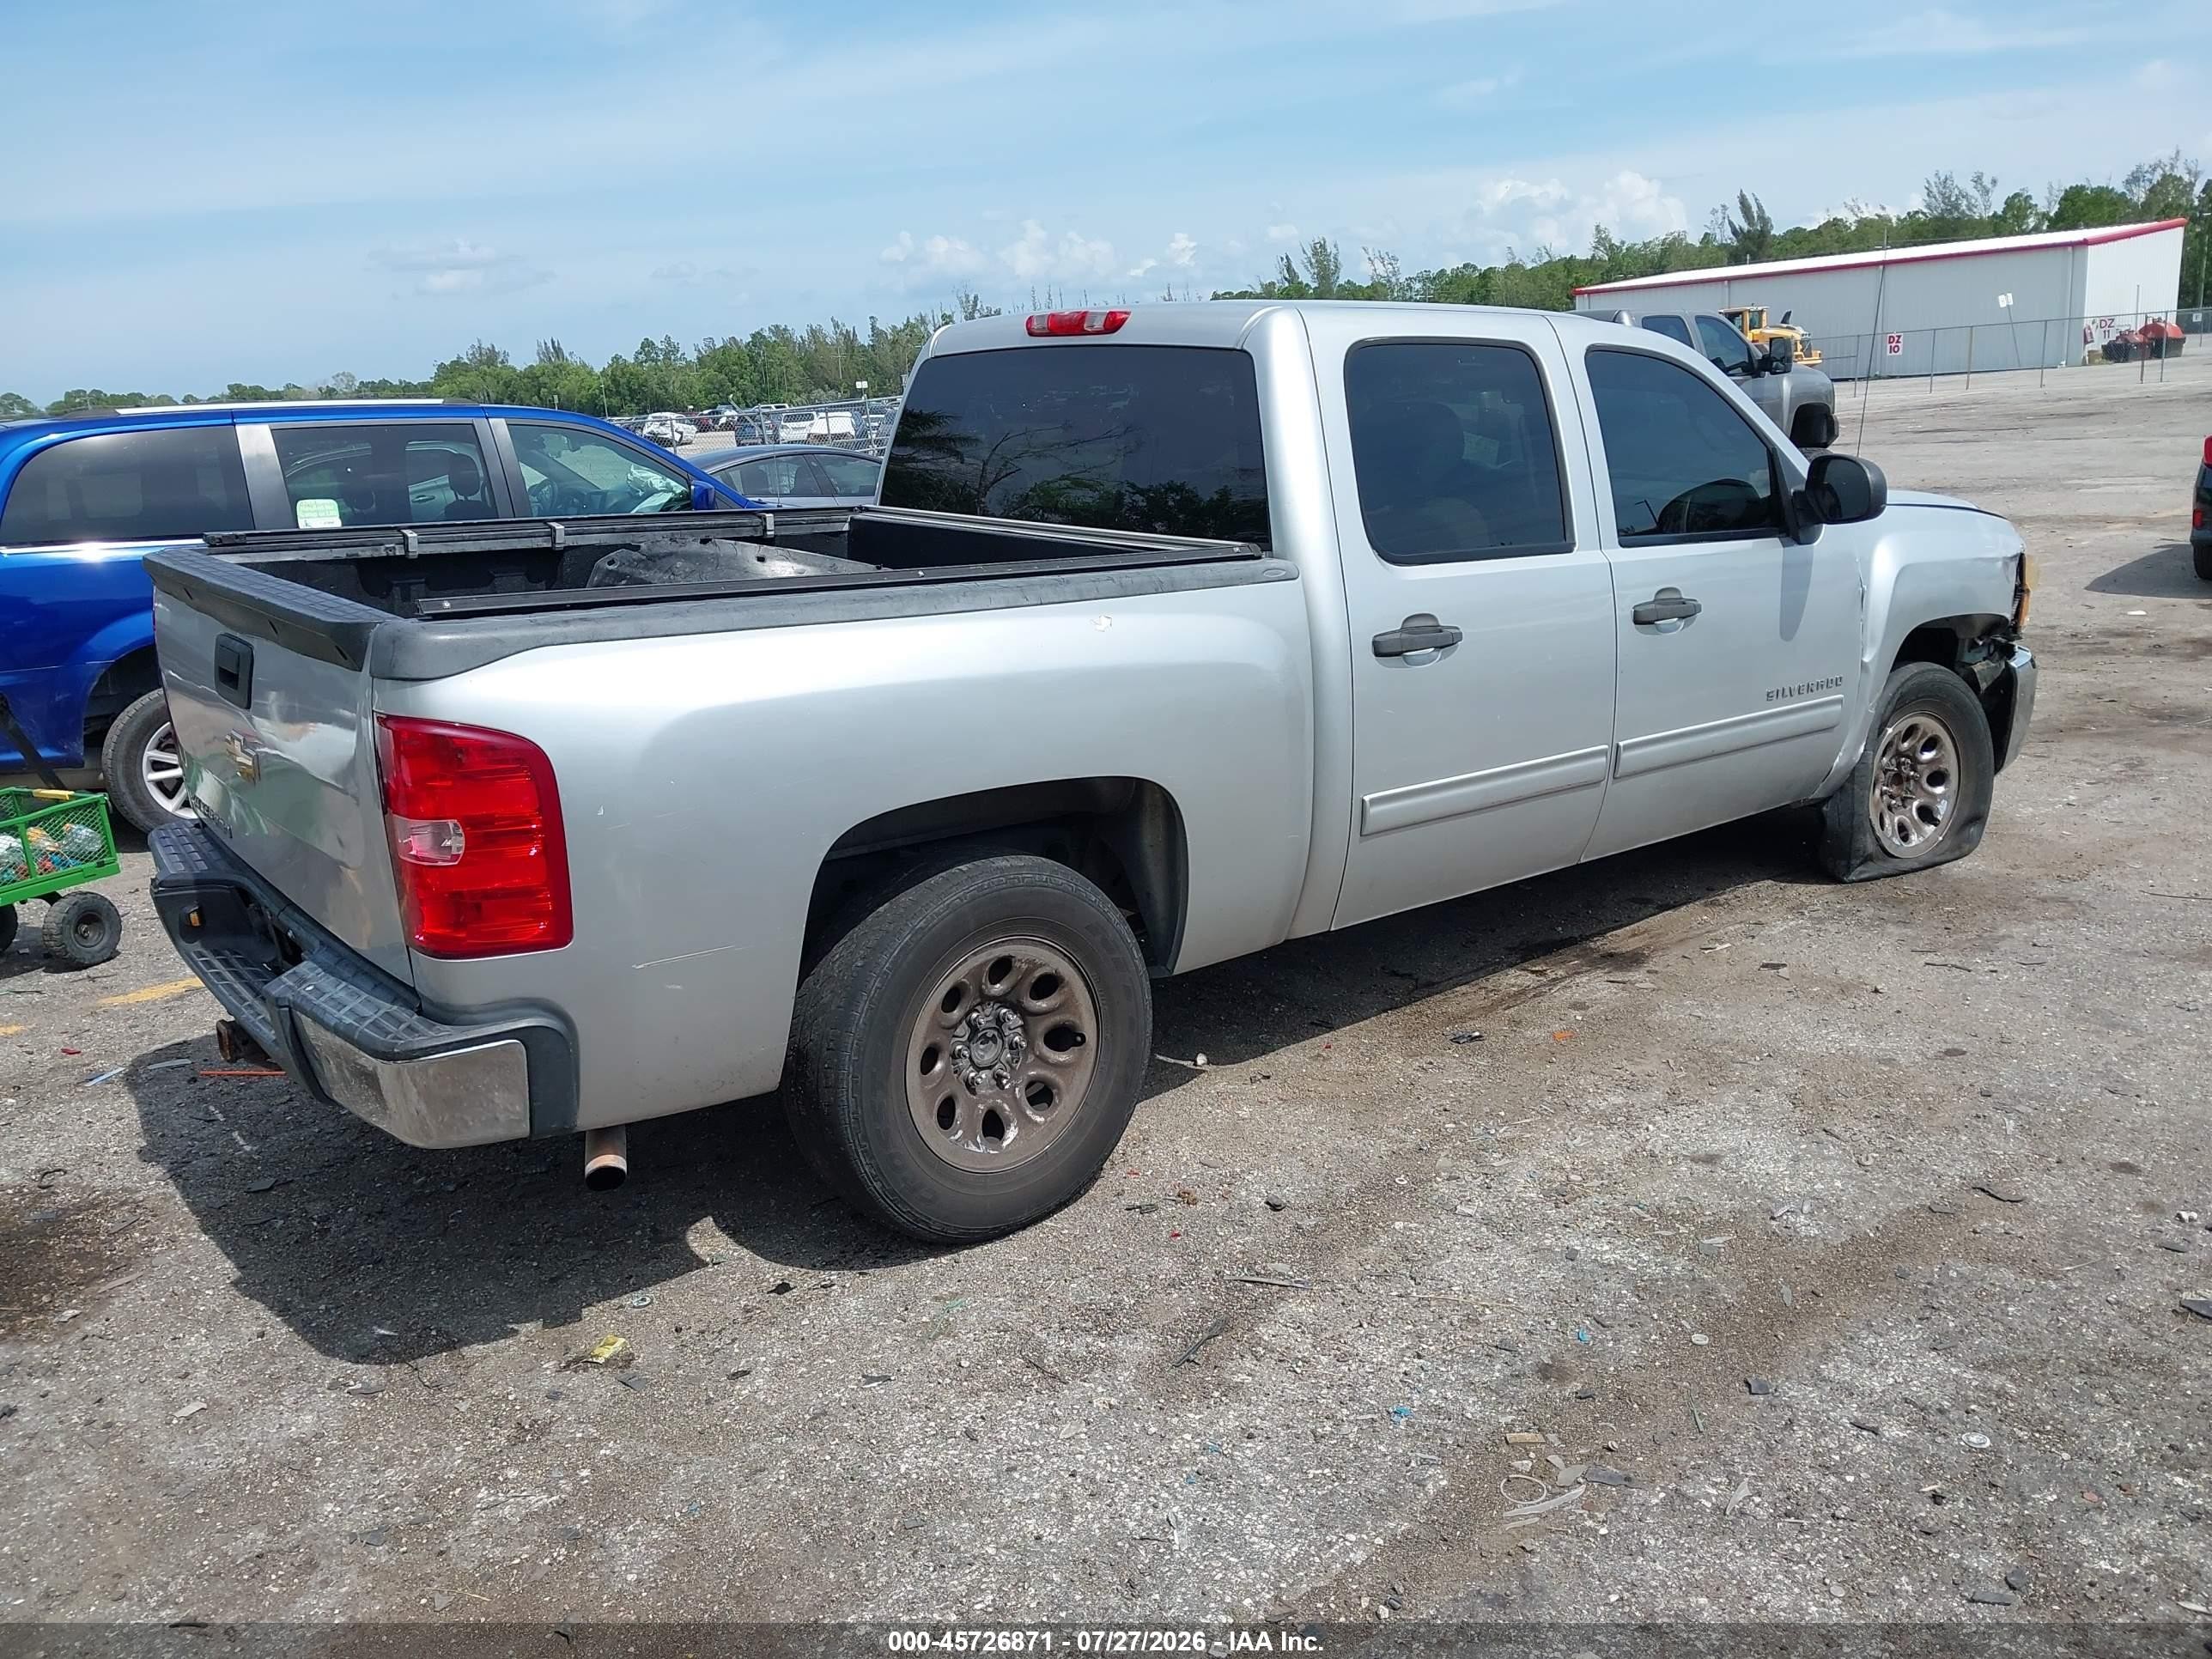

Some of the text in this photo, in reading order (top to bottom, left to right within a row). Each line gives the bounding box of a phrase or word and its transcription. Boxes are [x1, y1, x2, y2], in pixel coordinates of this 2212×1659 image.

[2100, 318, 2115, 329] DZ
[1888, 335, 1902, 344] DZ
[2103, 330, 2110, 339] 11
[1889, 344, 1900, 354] 10
[1766, 675, 1844, 702] SILVERADO
